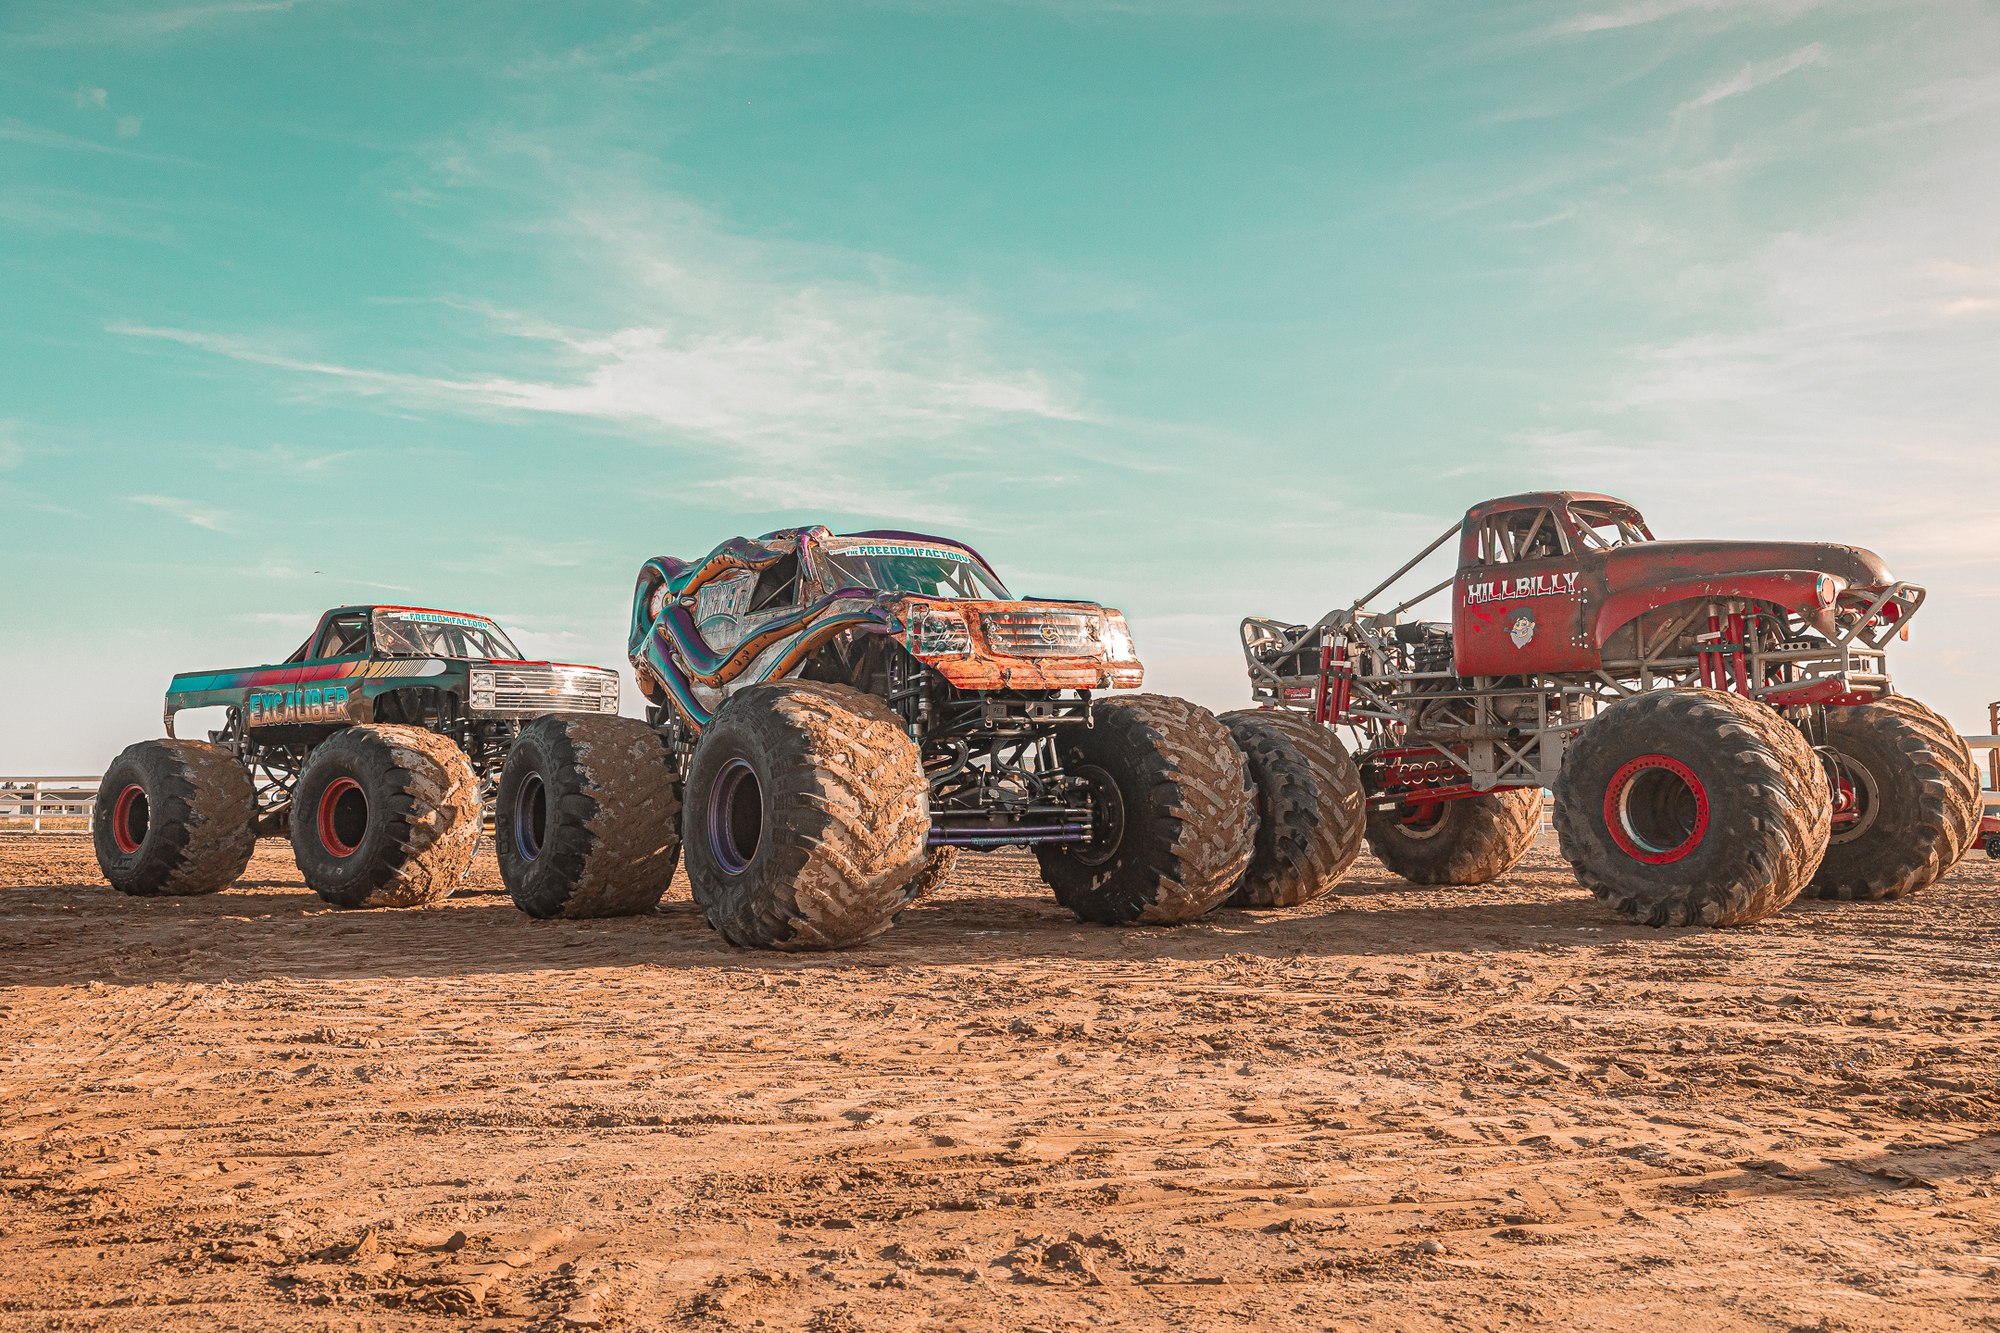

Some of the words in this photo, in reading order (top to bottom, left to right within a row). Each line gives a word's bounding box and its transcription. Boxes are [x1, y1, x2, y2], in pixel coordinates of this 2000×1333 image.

[859, 546, 917, 556] FREEDOM
[918, 548, 971, 562] FACTORY
[1467, 571, 1579, 605] HILLBILLY
[409, 613, 450, 624] FREEDOM
[451, 616, 488, 629] FACTORY
[249, 686, 352, 728] EXCALIBER
